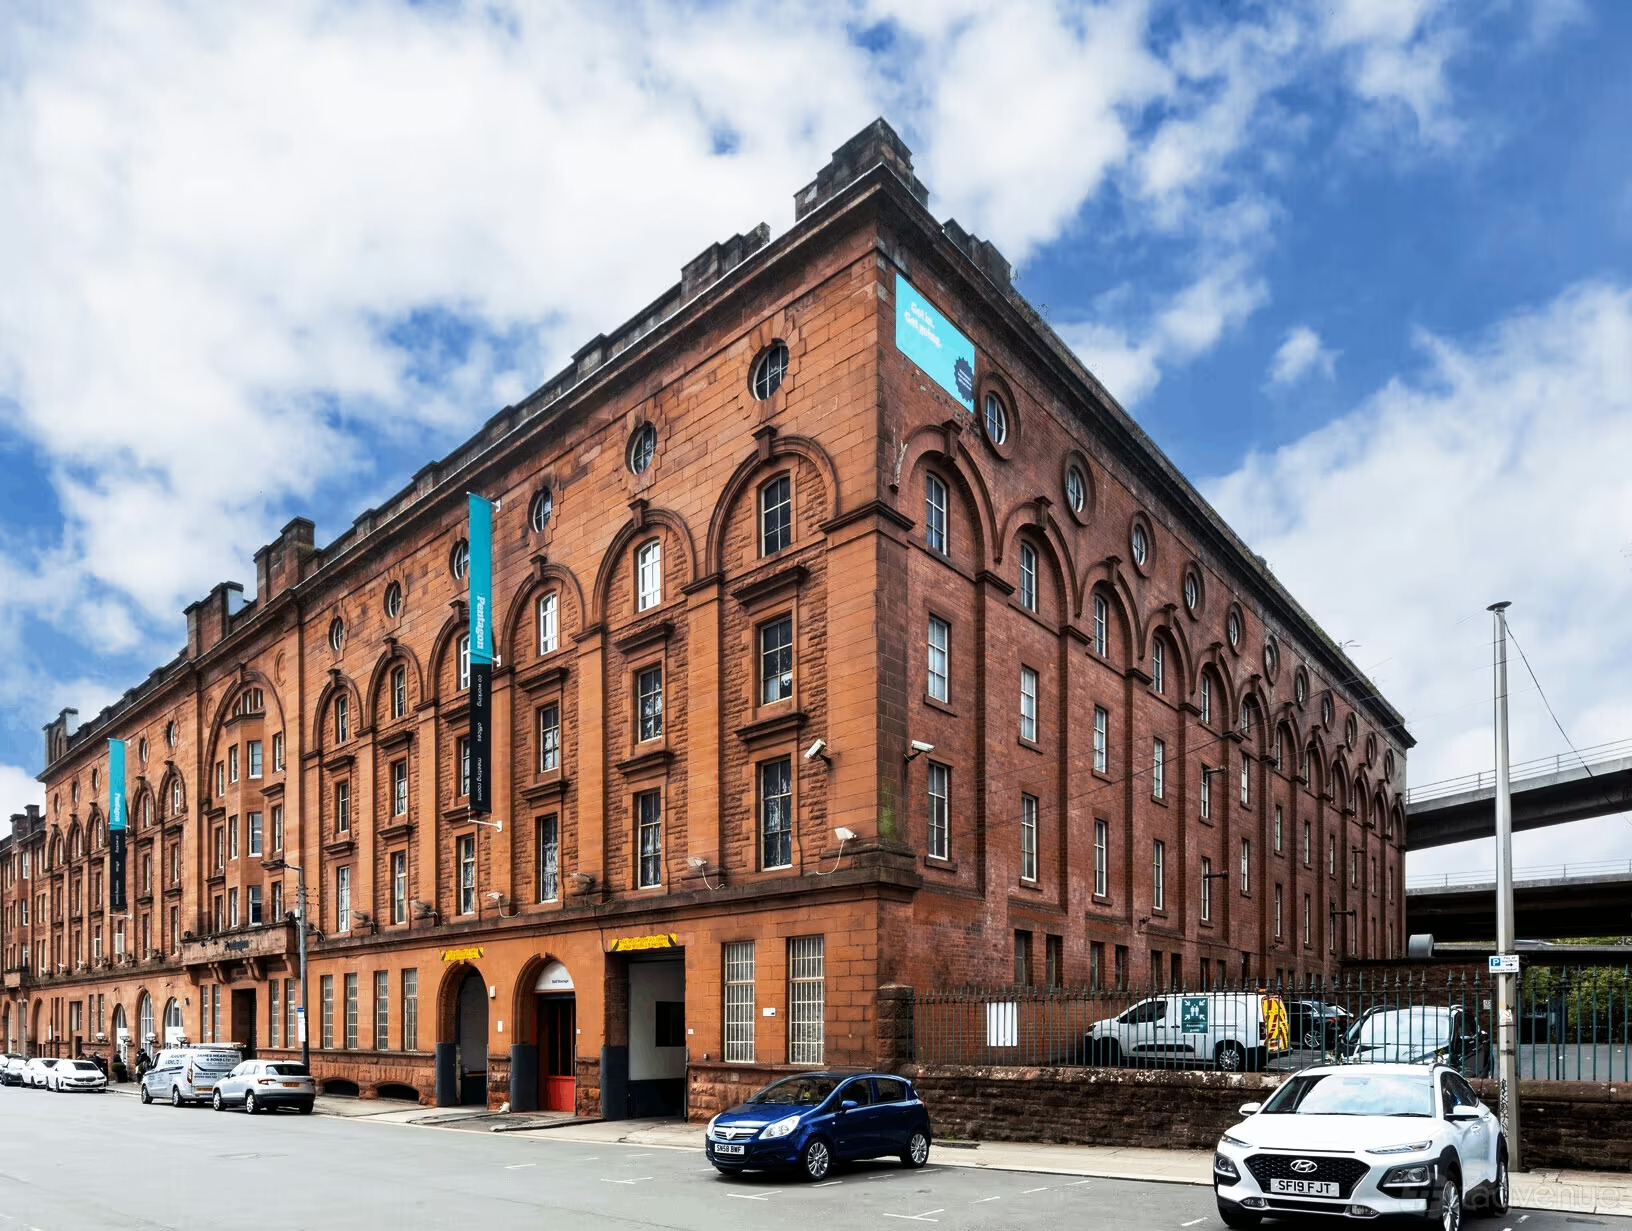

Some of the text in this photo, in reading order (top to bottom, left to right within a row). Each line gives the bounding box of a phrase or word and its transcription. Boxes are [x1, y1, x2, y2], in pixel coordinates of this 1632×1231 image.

[476, 595, 486, 650] Pentagon
[477, 674, 483, 683] co
[1493, 958, 1500, 966] P
[1278, 1180, 1331, 1194] SF19 FJT
